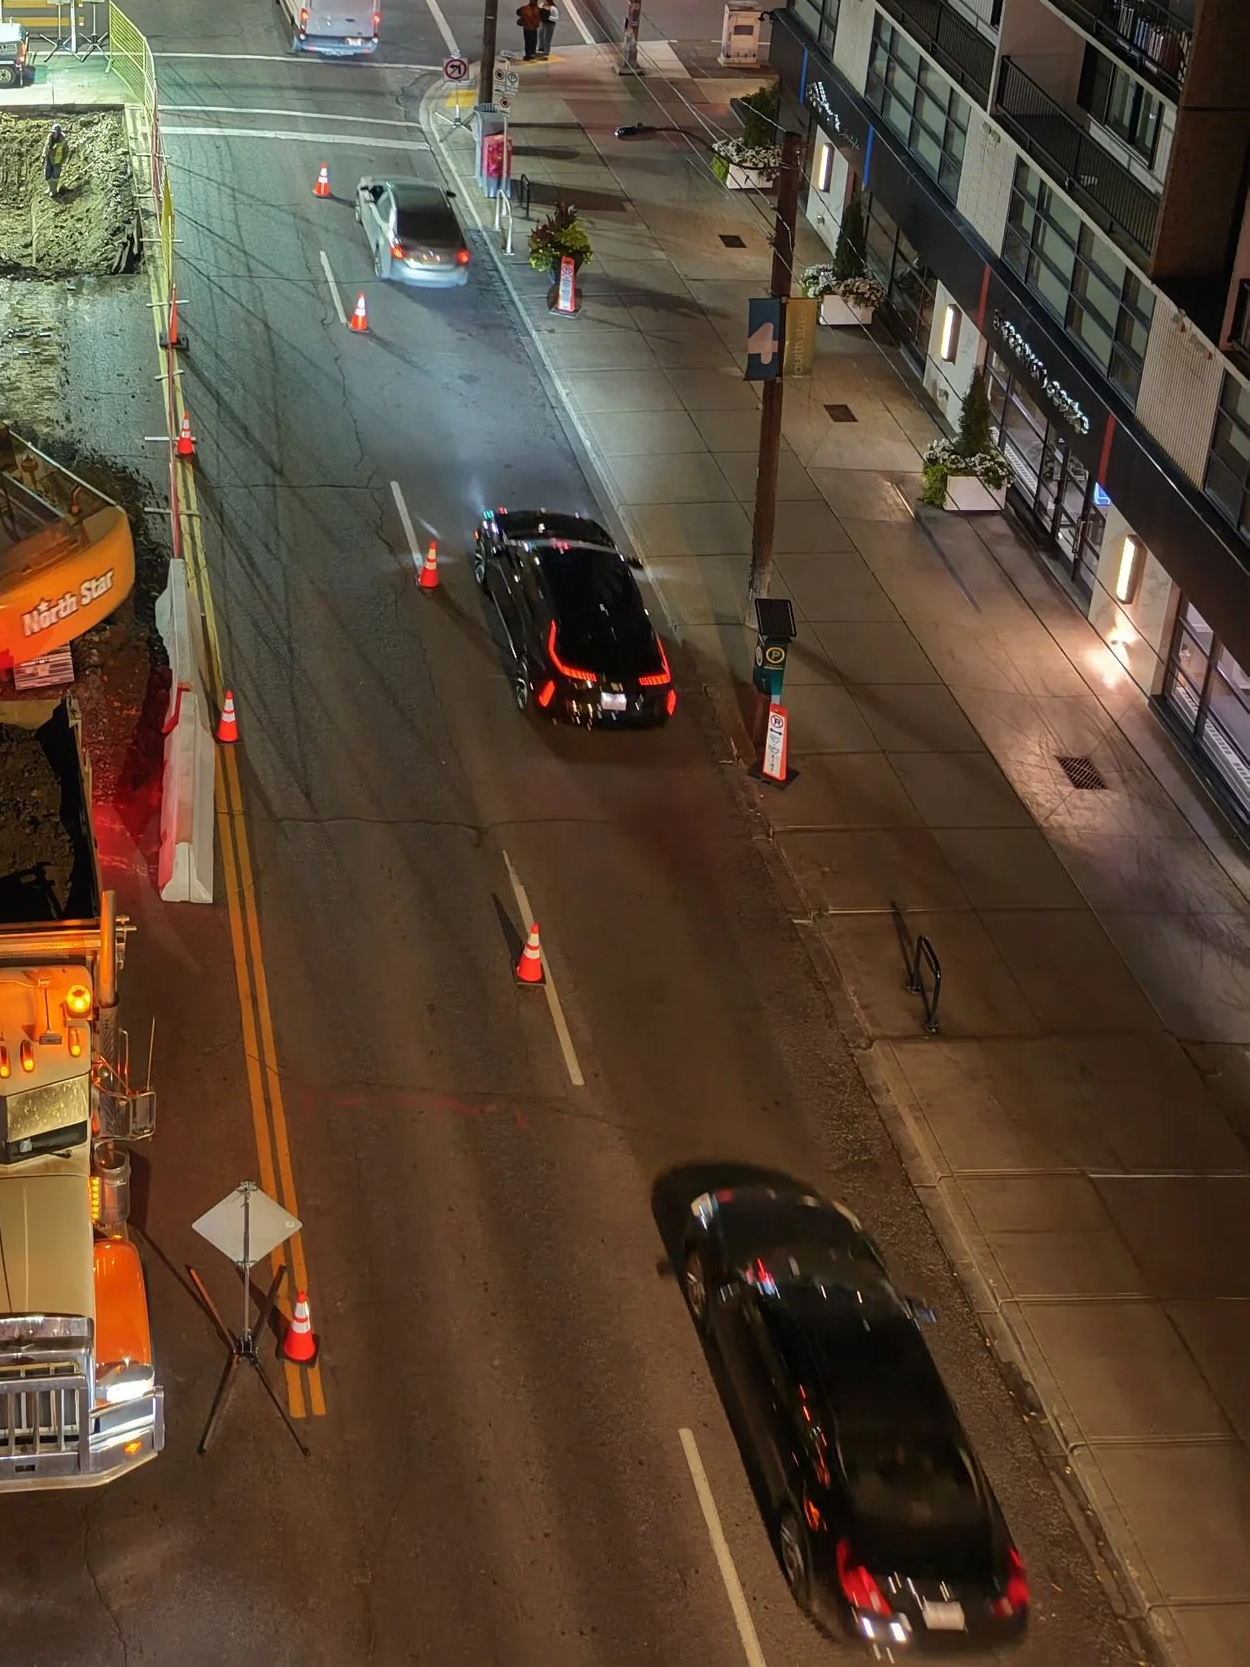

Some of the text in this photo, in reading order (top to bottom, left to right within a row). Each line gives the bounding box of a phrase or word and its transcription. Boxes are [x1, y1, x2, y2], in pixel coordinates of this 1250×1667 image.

[747, 321, 779, 365] 4
[21, 567, 115, 638] North Star
